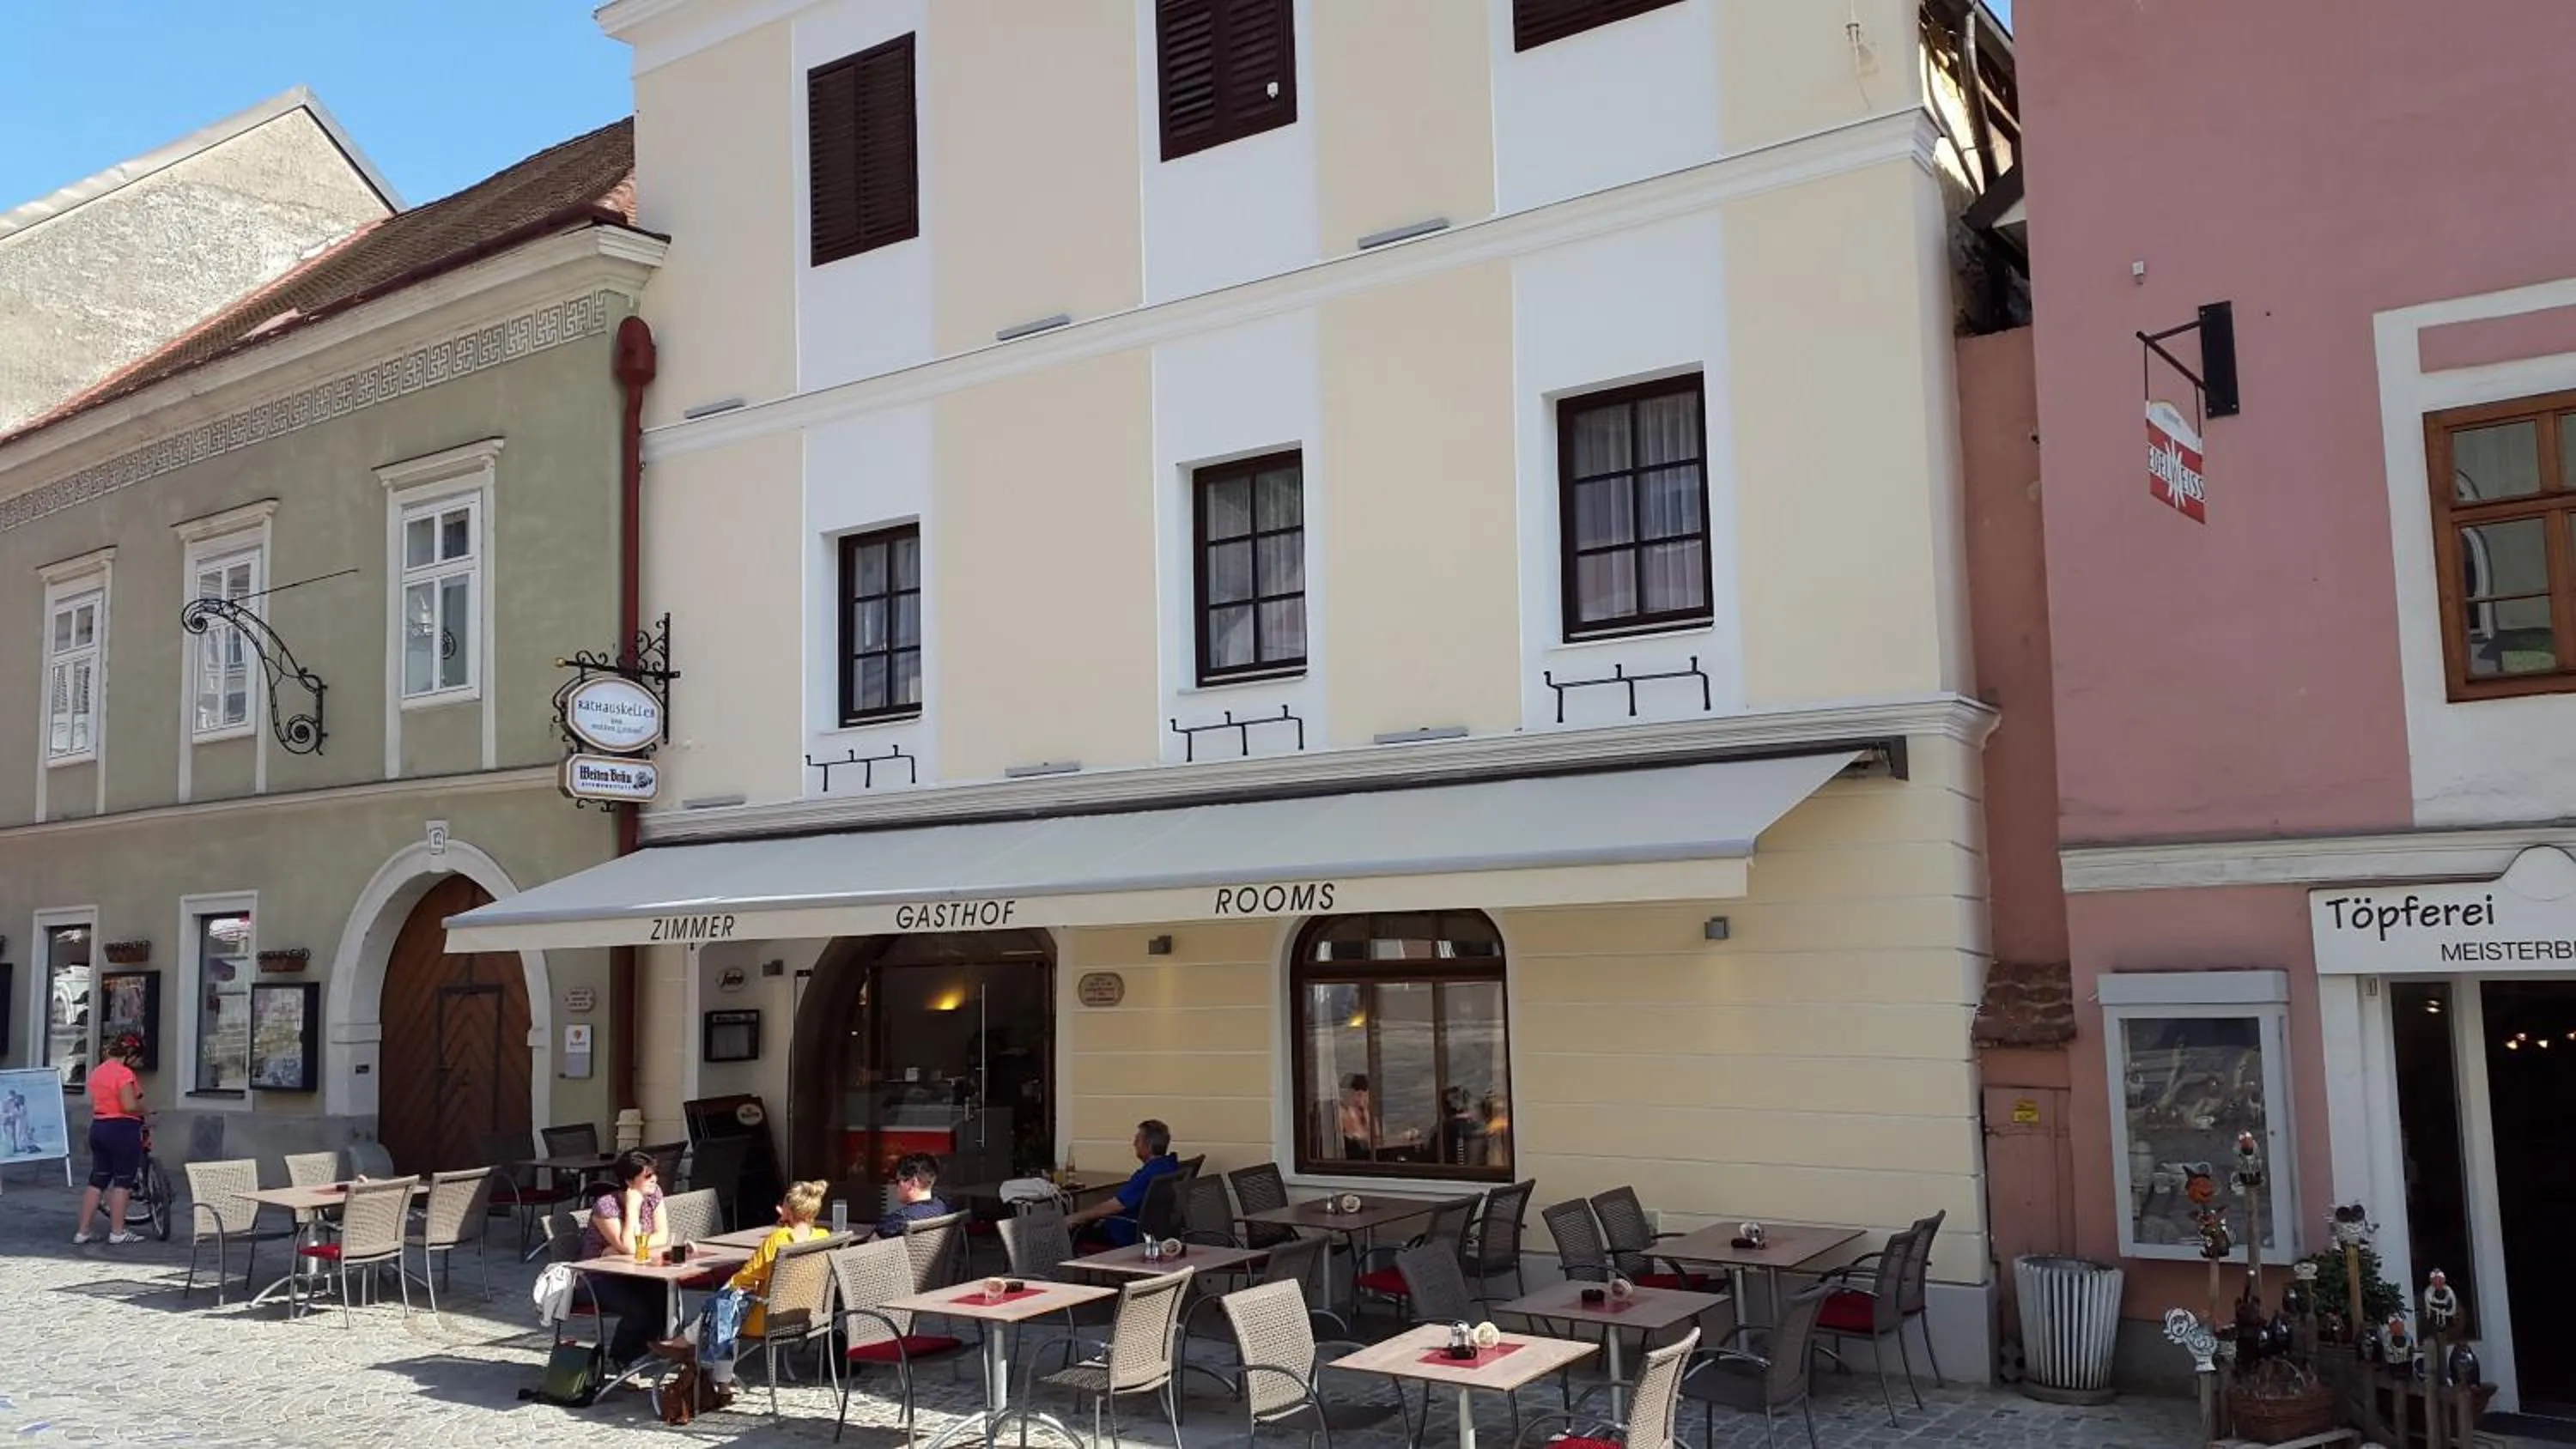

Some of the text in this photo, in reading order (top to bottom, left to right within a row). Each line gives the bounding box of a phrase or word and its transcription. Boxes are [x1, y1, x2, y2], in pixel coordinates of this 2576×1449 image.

[1215, 883, 1335, 913] ROOMS
[650, 915, 735, 940] ZIMMER
[896, 900, 1016, 929] GASTHOF
[2325, 894, 2494, 941] Töpferei
[2441, 941, 2576, 961] MEISTERB
